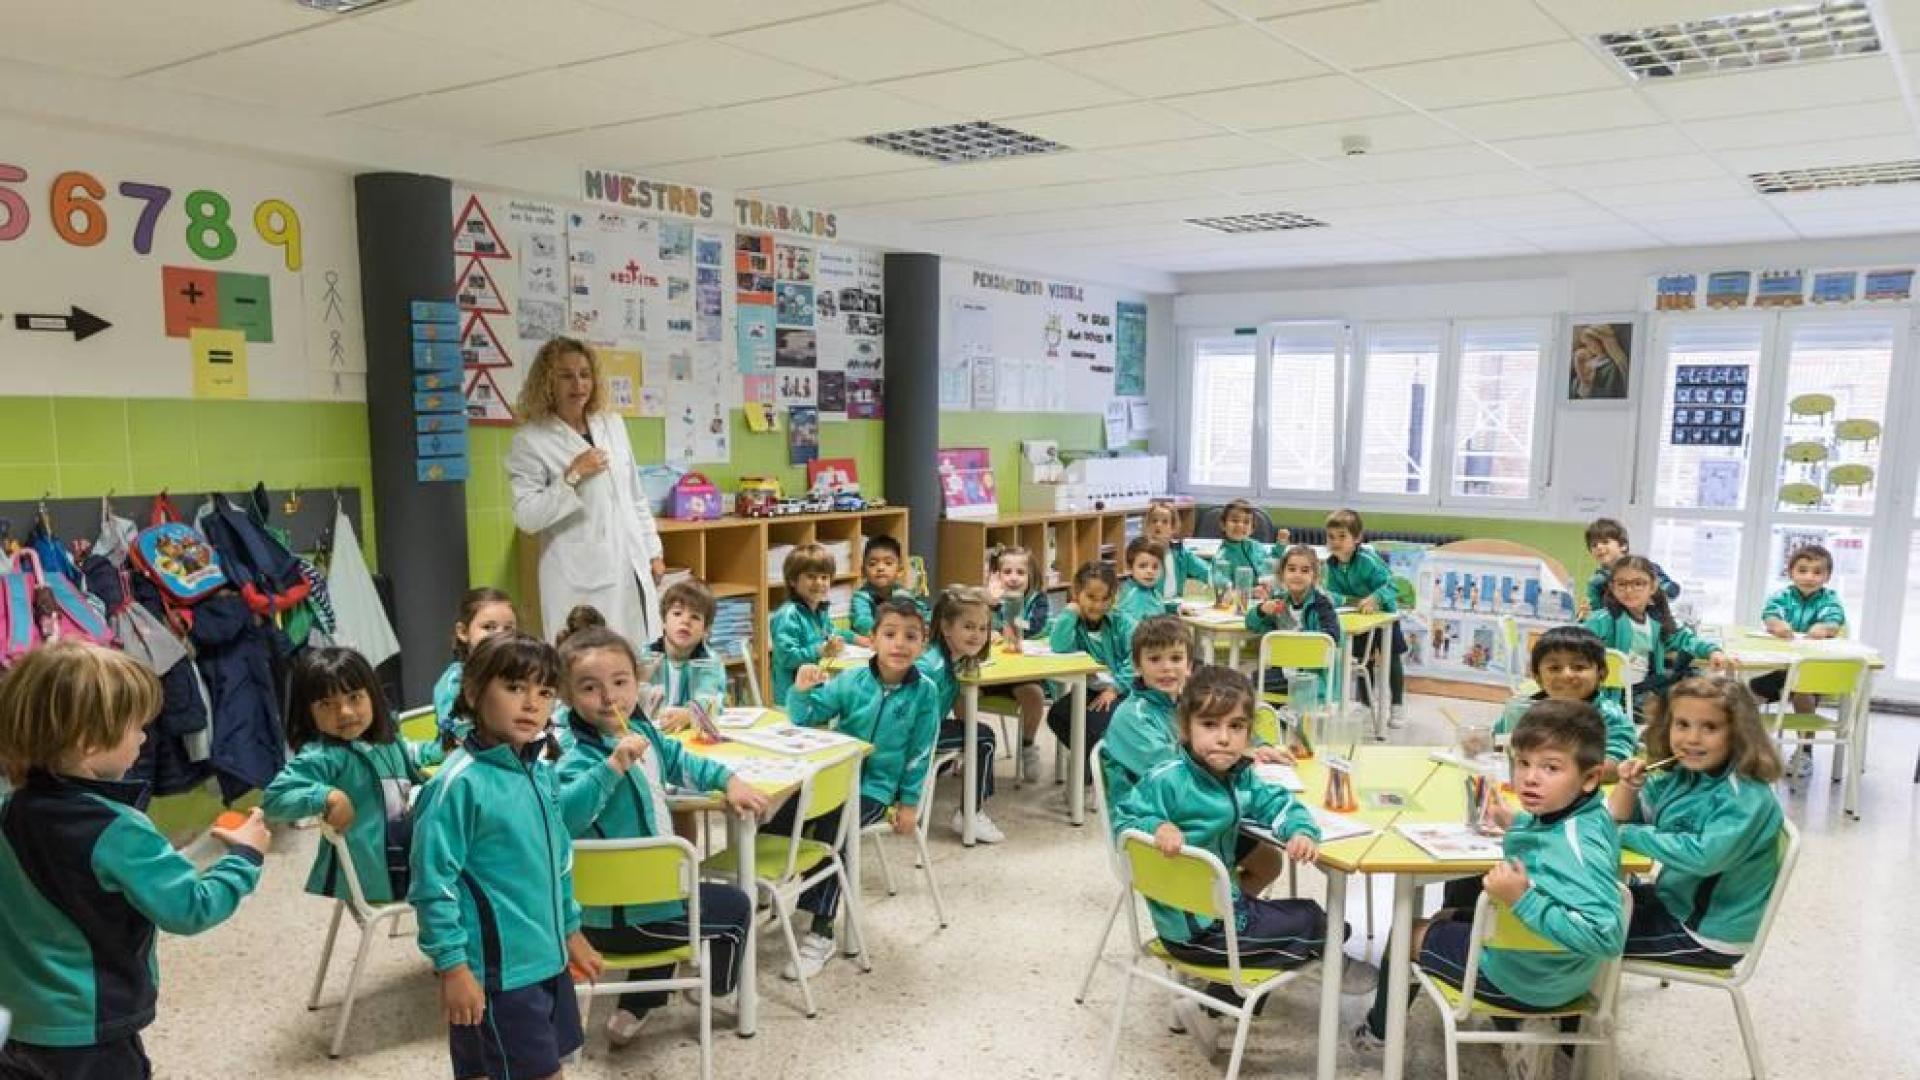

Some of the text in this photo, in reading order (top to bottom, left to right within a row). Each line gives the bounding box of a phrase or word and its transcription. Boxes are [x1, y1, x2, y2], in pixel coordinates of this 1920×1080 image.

[50, 170, 108, 247] 6
[118, 181, 172, 254] 7
[185, 189, 238, 261] 8
[253, 198, 303, 273] 9
[584, 169, 837, 239] NUESTROS TRABAJOS
